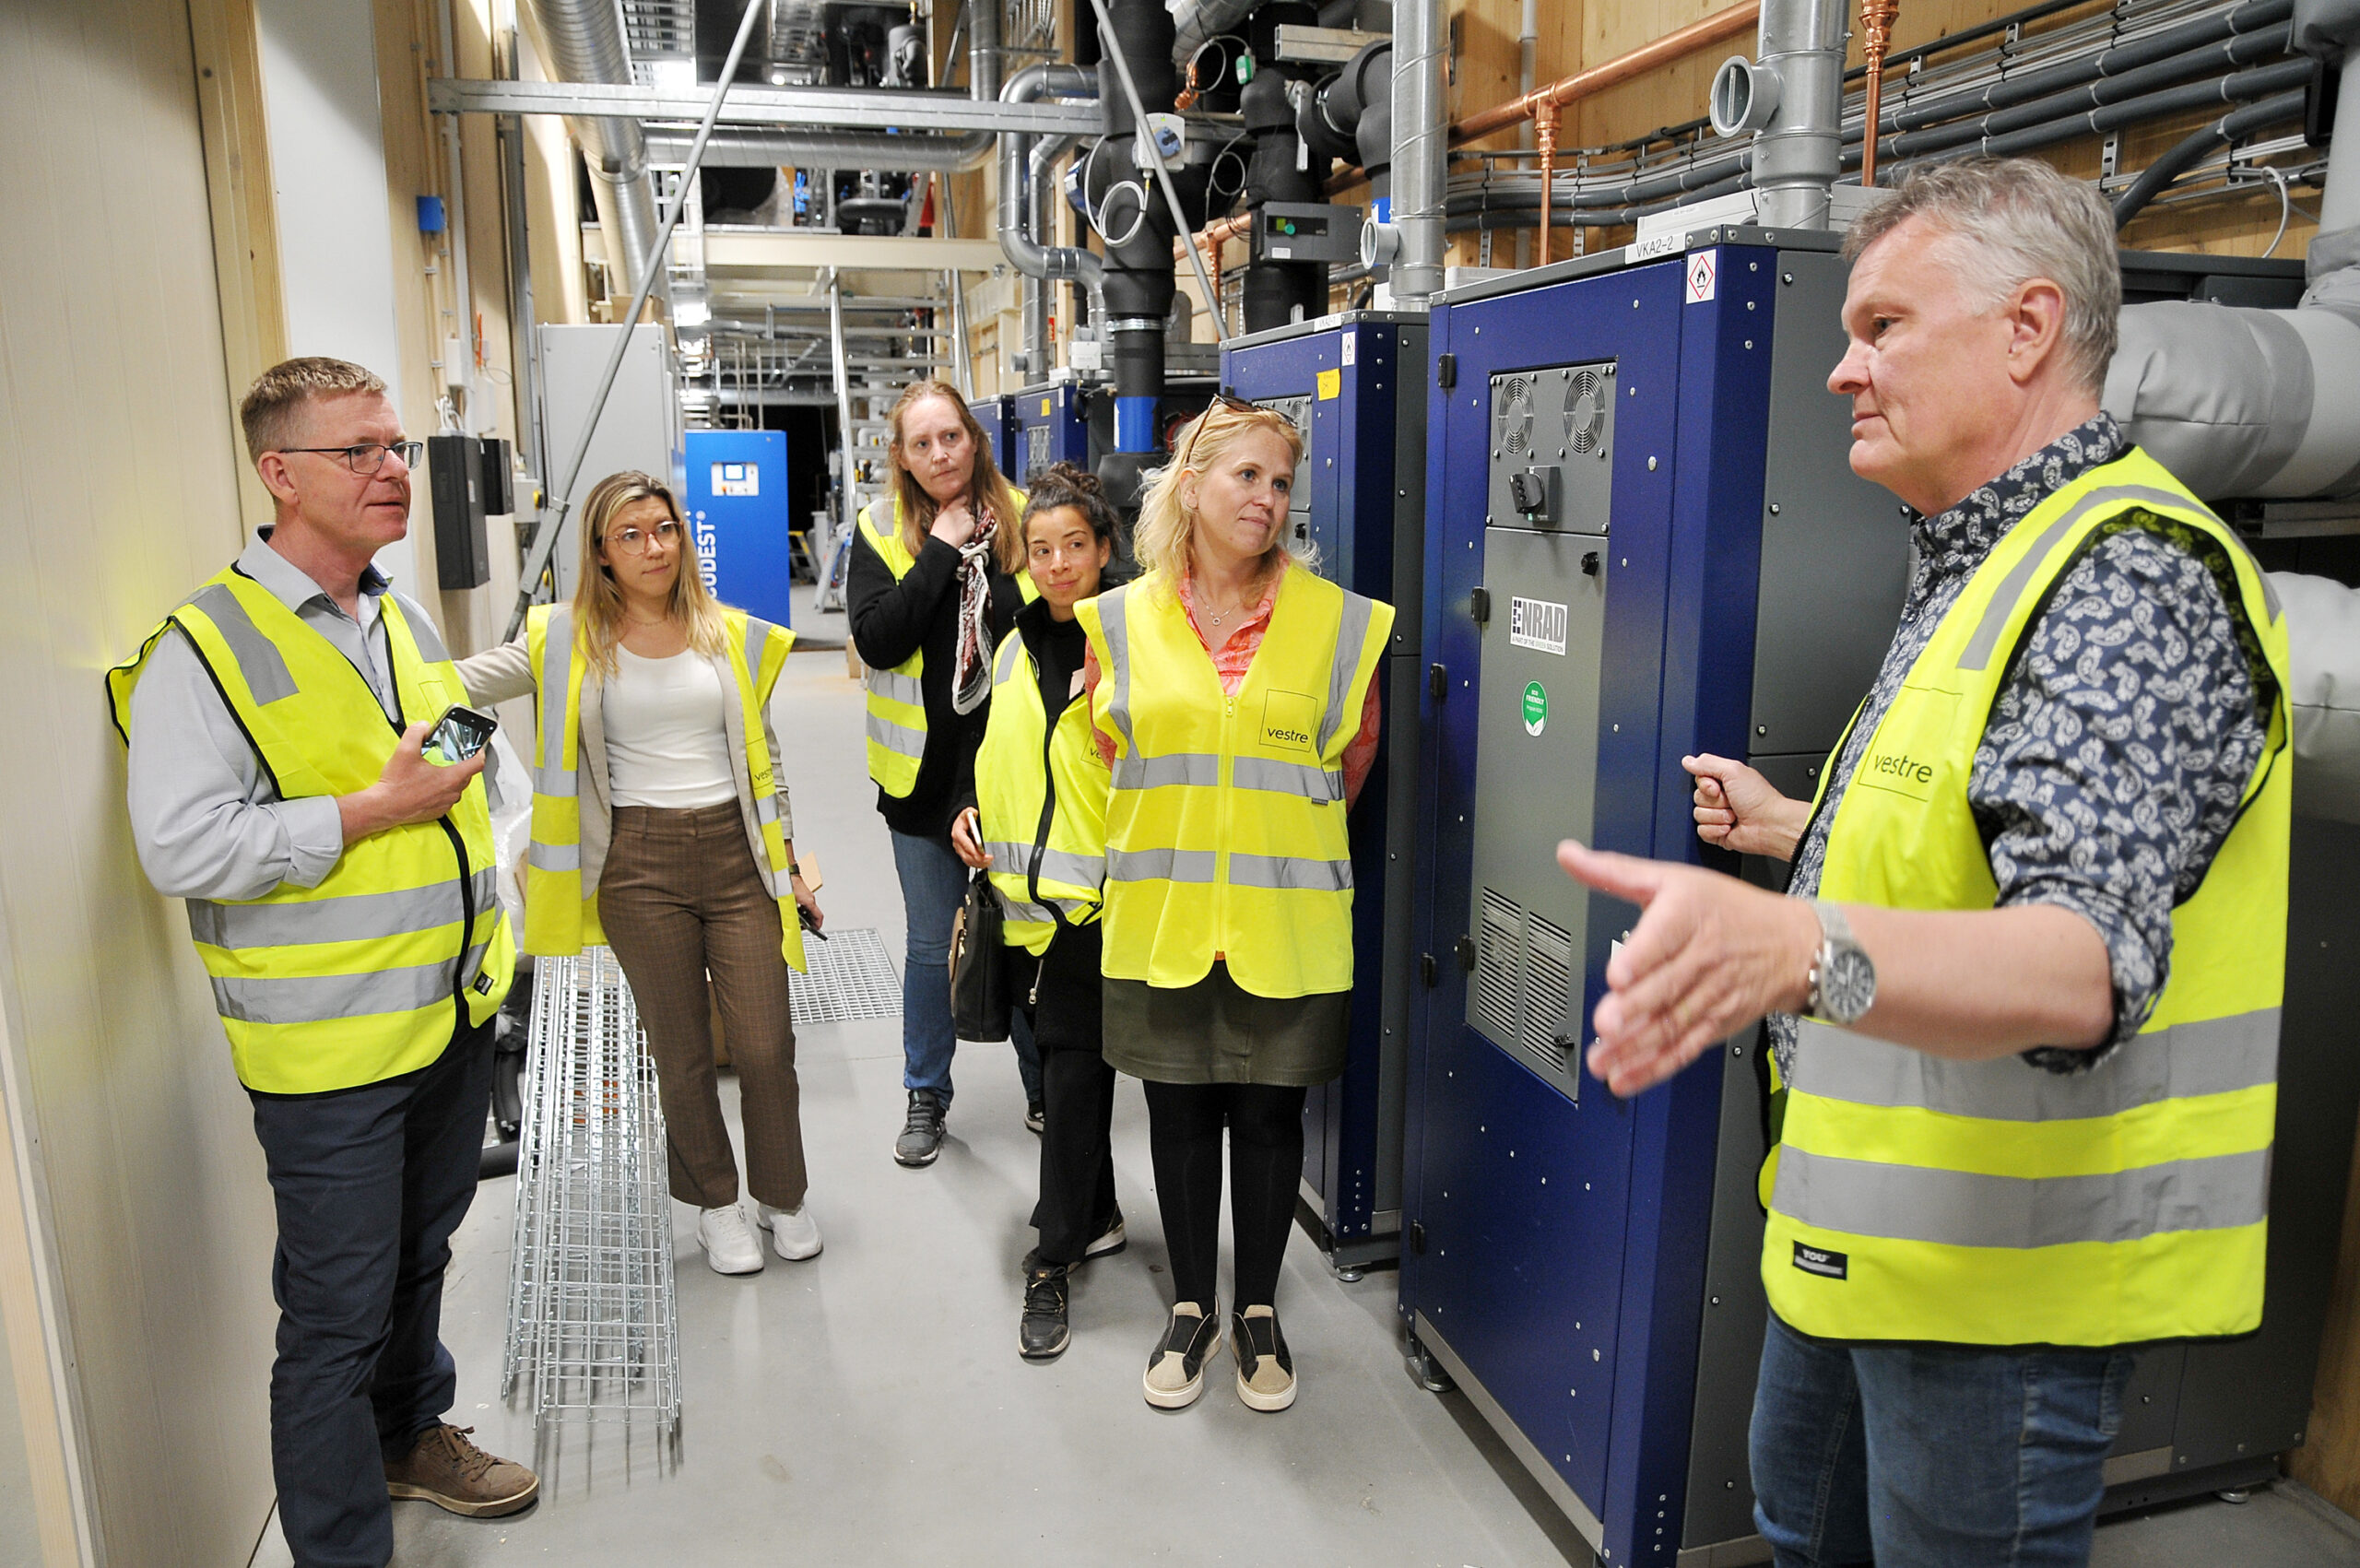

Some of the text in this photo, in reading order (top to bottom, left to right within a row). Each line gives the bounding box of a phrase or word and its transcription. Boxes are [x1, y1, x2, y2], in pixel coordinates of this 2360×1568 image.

[1636, 236, 1673, 257] VKA2-2
[1512, 599, 1565, 643] ENRAD
[1268, 727, 1309, 744] vestre
[1874, 755, 1932, 784] vestre
